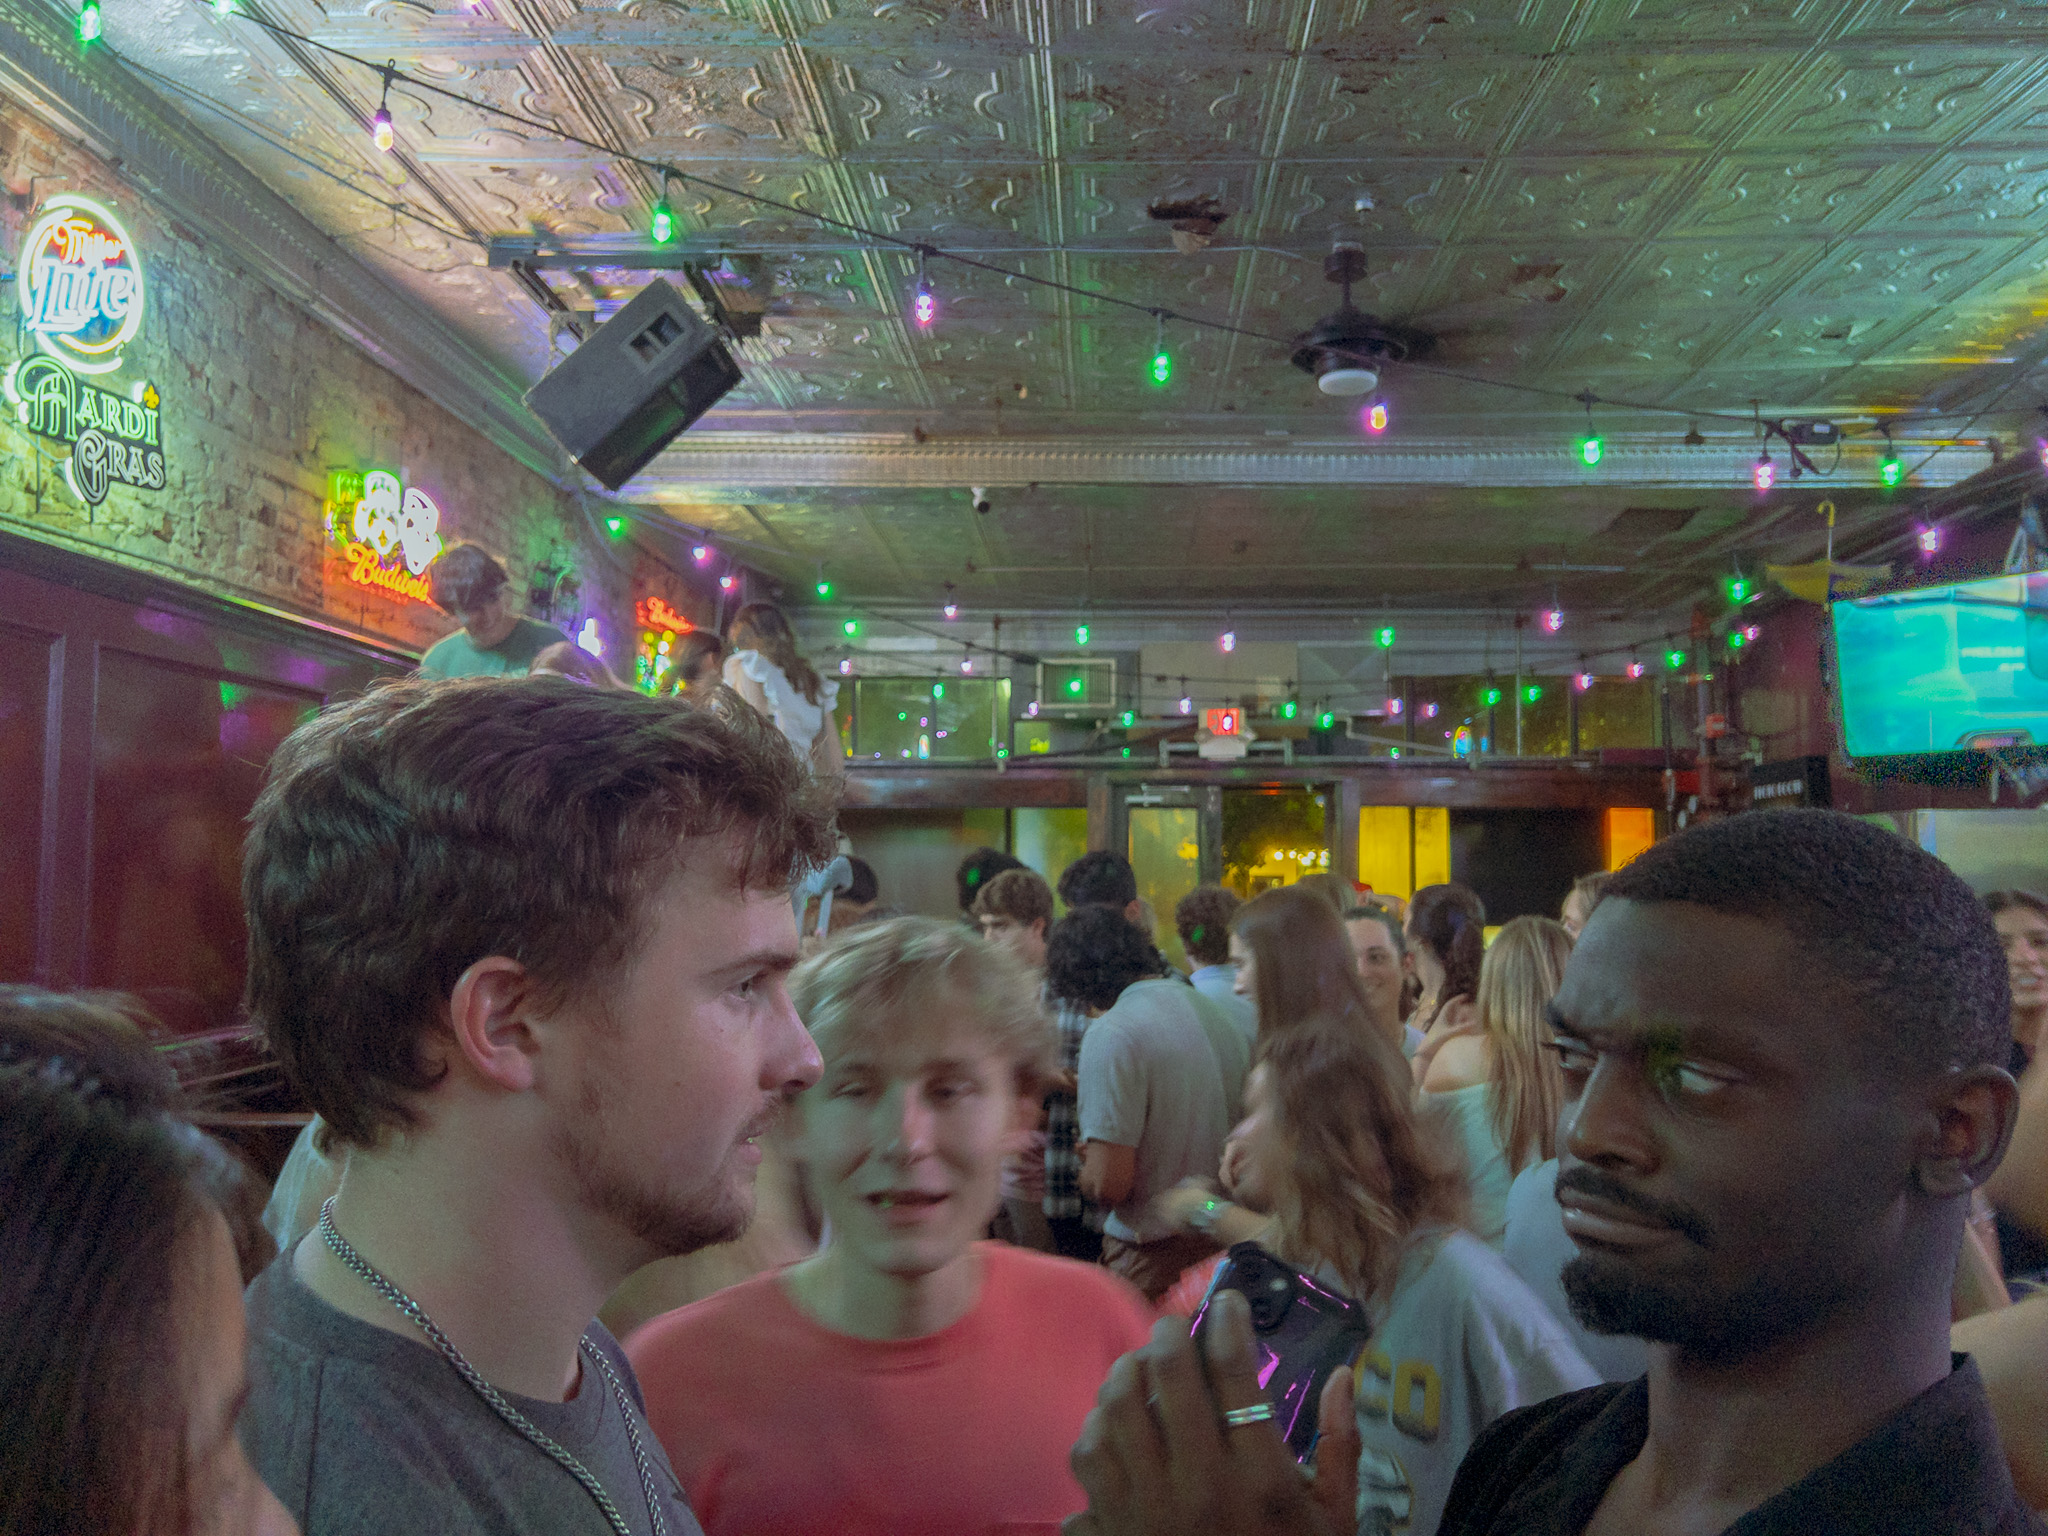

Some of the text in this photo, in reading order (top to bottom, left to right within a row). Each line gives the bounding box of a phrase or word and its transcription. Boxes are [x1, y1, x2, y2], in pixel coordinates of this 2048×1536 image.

[52, 219, 126, 264] Miller
[26, 257, 134, 332] Lite
[345, 542, 430, 602] Budweis
